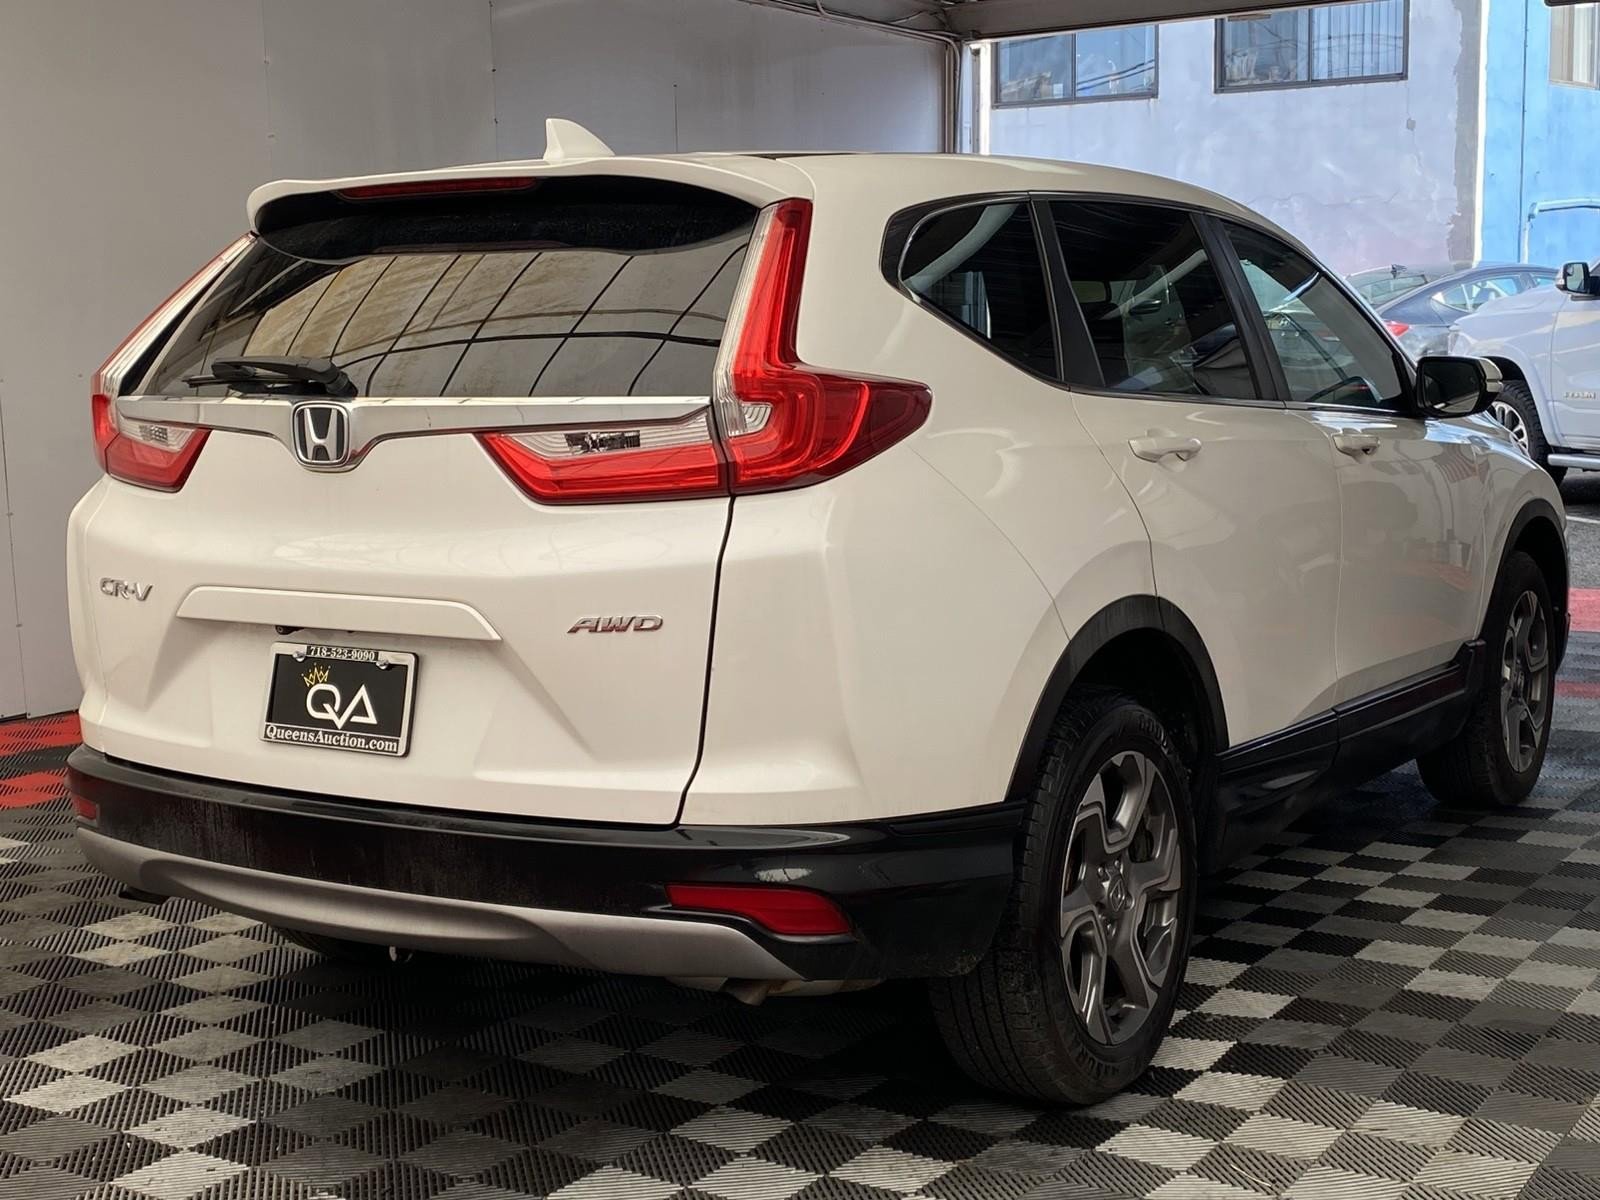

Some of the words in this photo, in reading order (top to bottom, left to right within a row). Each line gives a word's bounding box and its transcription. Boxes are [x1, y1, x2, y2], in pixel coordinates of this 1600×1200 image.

[100, 577, 153, 602] CR-V
[566, 614, 664, 634] AWD
[309, 646, 376, 662] 718-523-9090
[306, 683, 379, 730] QA
[265, 724, 398, 752] QueensAuction.com
